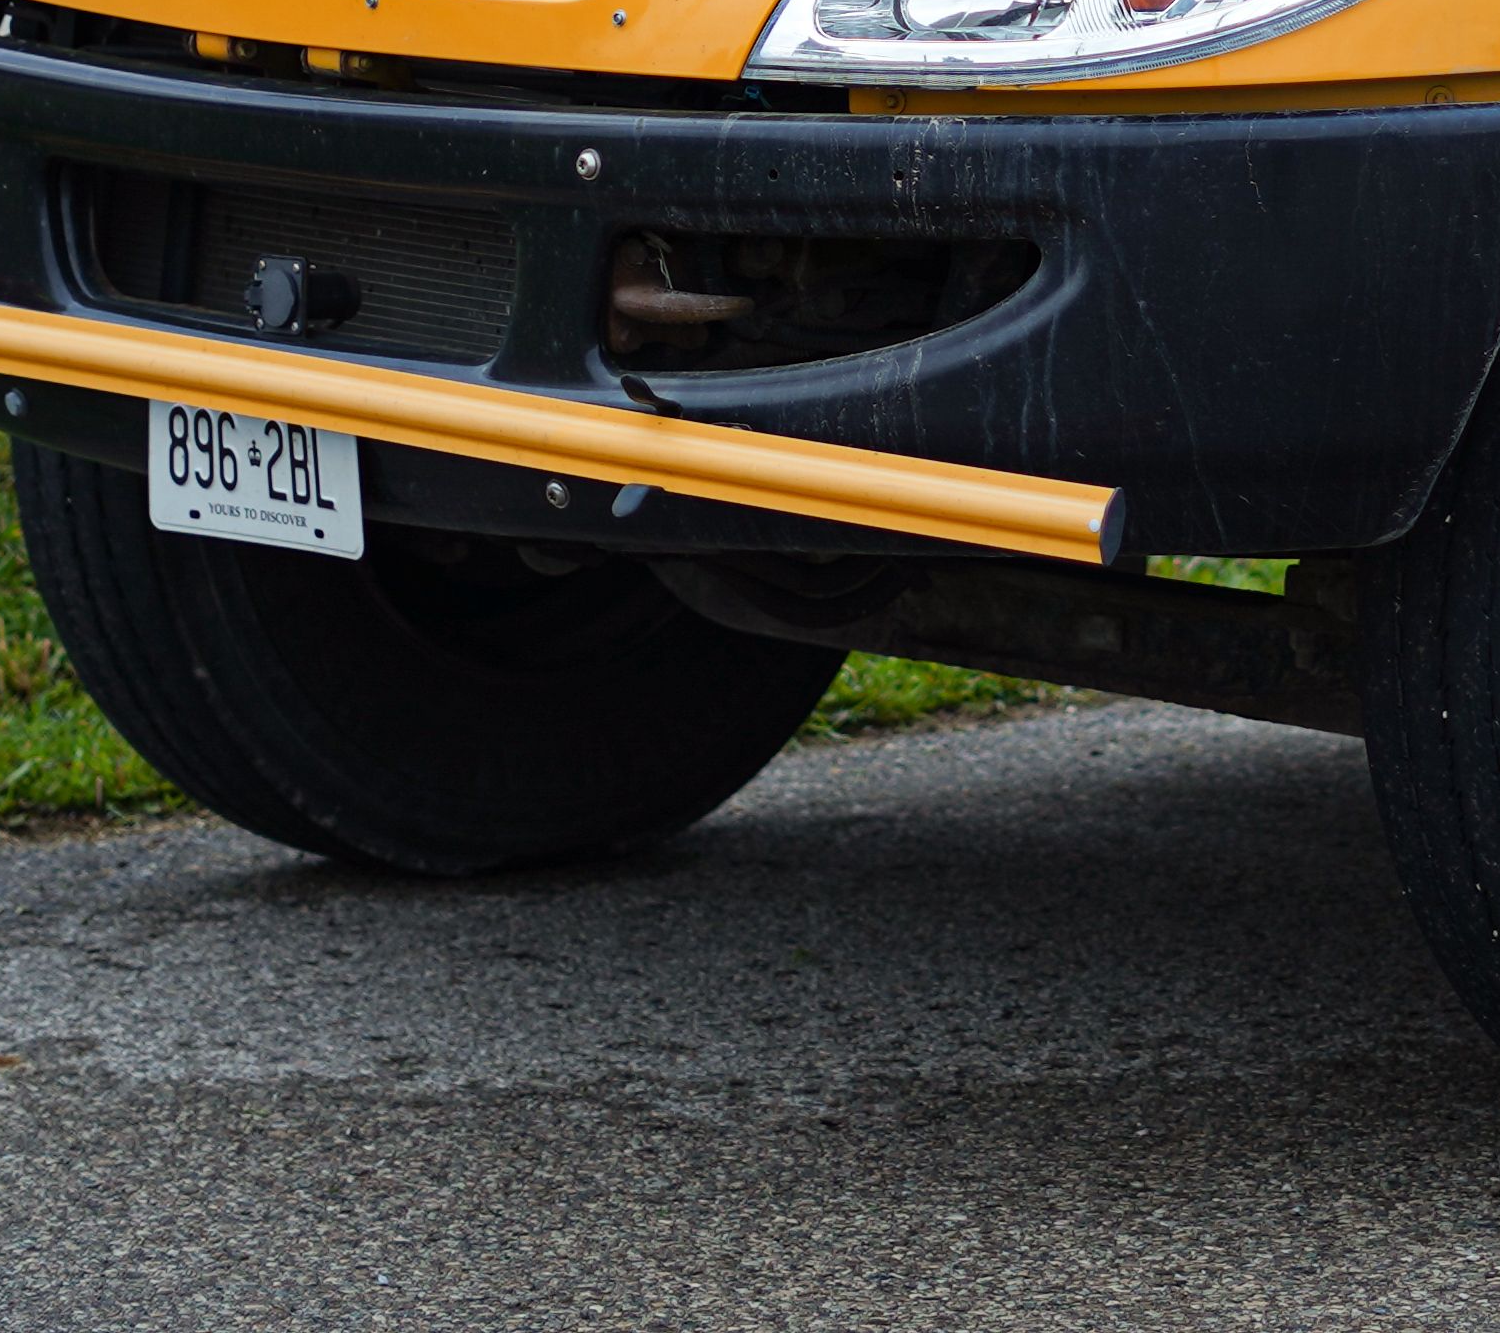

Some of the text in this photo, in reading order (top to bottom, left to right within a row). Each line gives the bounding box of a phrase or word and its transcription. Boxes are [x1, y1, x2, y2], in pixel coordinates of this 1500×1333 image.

[169, 406, 336, 511] 896 2BL
[208, 502, 308, 528] YOURS TO DISCOVER
